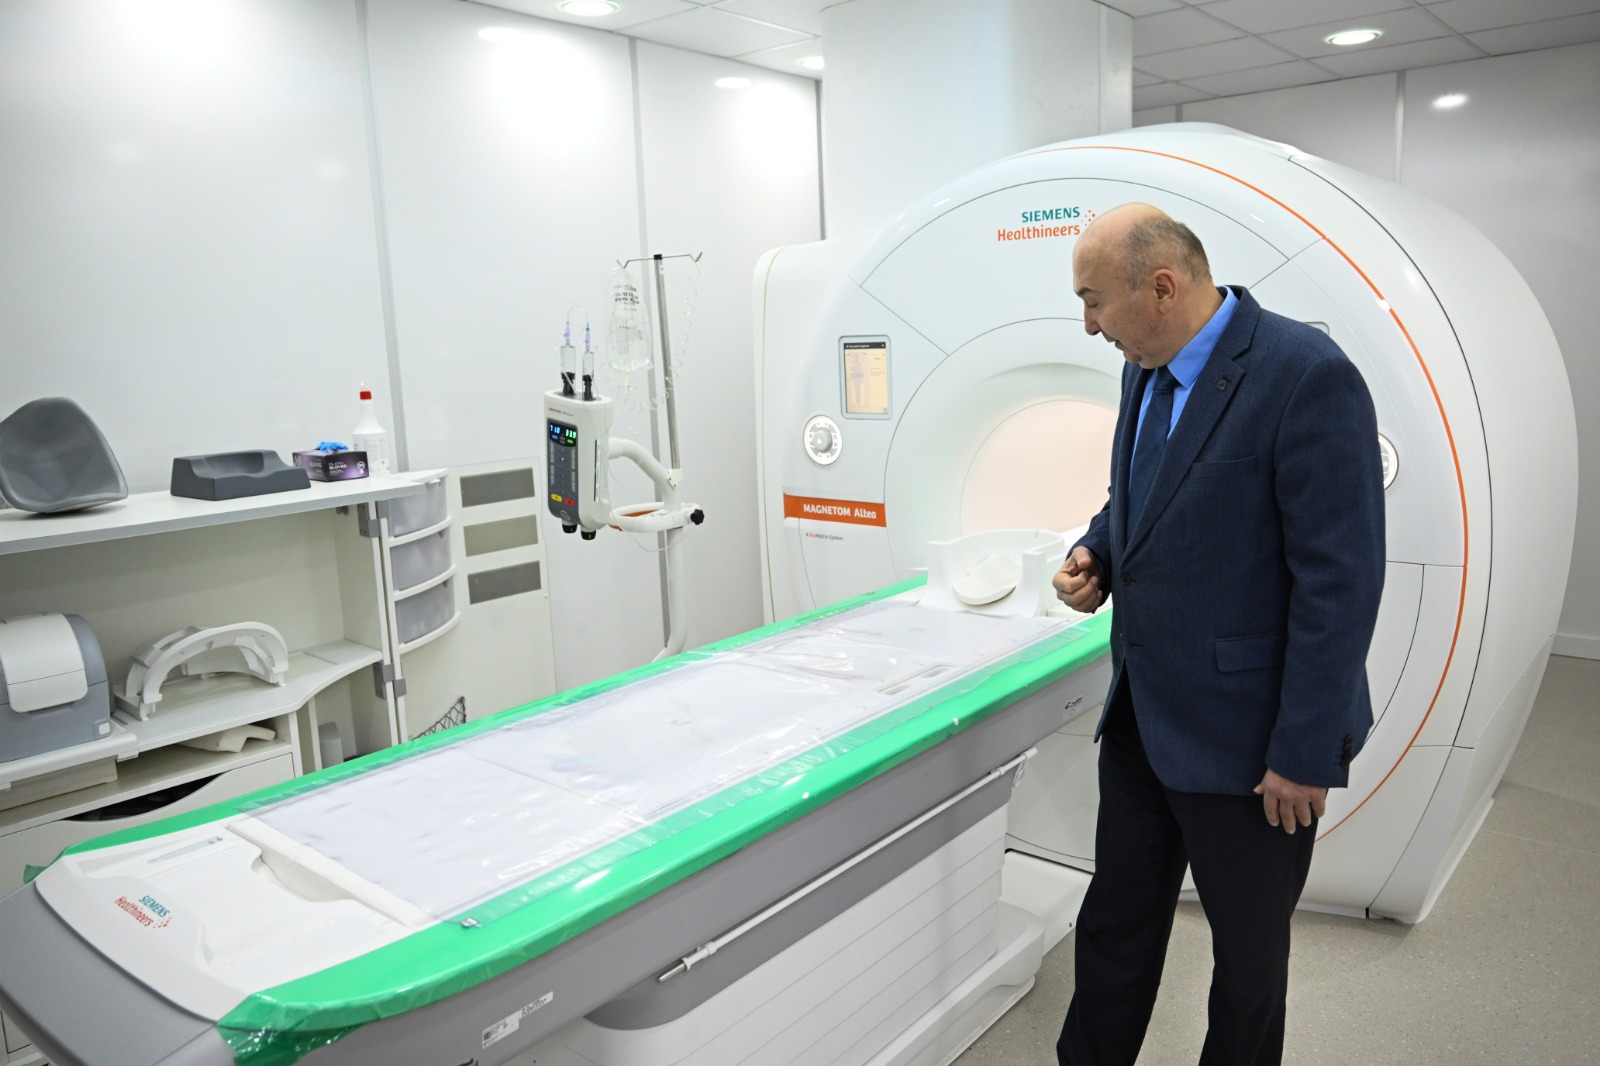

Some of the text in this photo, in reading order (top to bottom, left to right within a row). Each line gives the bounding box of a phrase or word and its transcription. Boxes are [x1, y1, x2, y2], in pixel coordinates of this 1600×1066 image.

[1022, 206, 1080, 223] SIEMENS
[997, 224, 1080, 242] Healthineers
[803, 504, 876, 519] MAGNETOM Altea
[114, 896, 154, 927] Healthineers
[138, 896, 170, 918] SIEMENS
